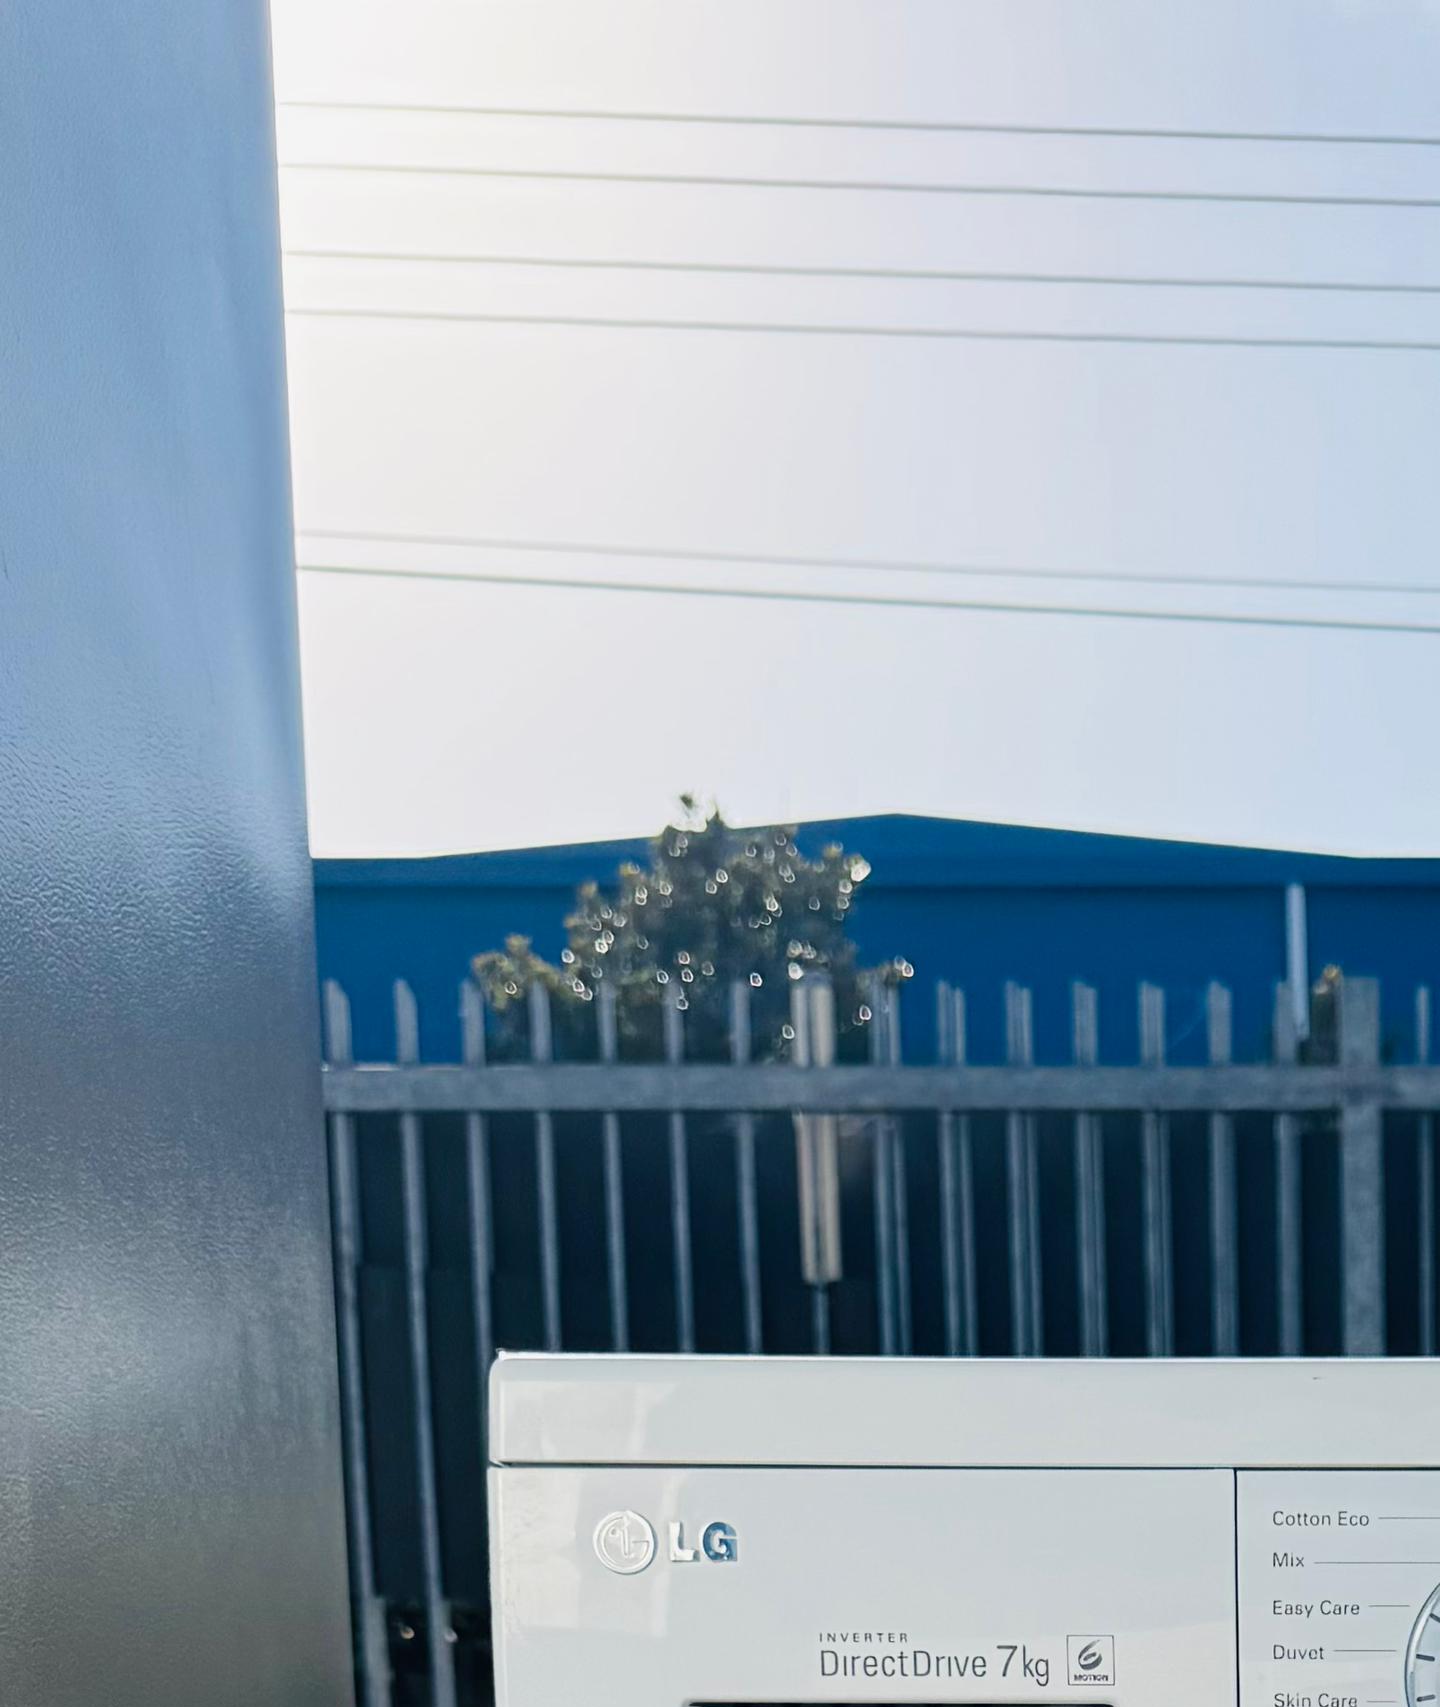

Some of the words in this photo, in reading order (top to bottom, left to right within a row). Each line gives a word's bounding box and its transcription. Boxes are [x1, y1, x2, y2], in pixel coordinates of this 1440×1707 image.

[1273, 1511, 1331, 1527] Cotton
[1338, 1511, 1370, 1527] Eco
[667, 1520, 738, 1562] LG
[1273, 1553, 1304, 1568] Mix
[1273, 1600, 1315, 1619] Easy
[1323, 1600, 1360, 1616] Care
[820, 1633, 908, 1643] INVERTER
[1273, 1645, 1324, 1660] Duvet
